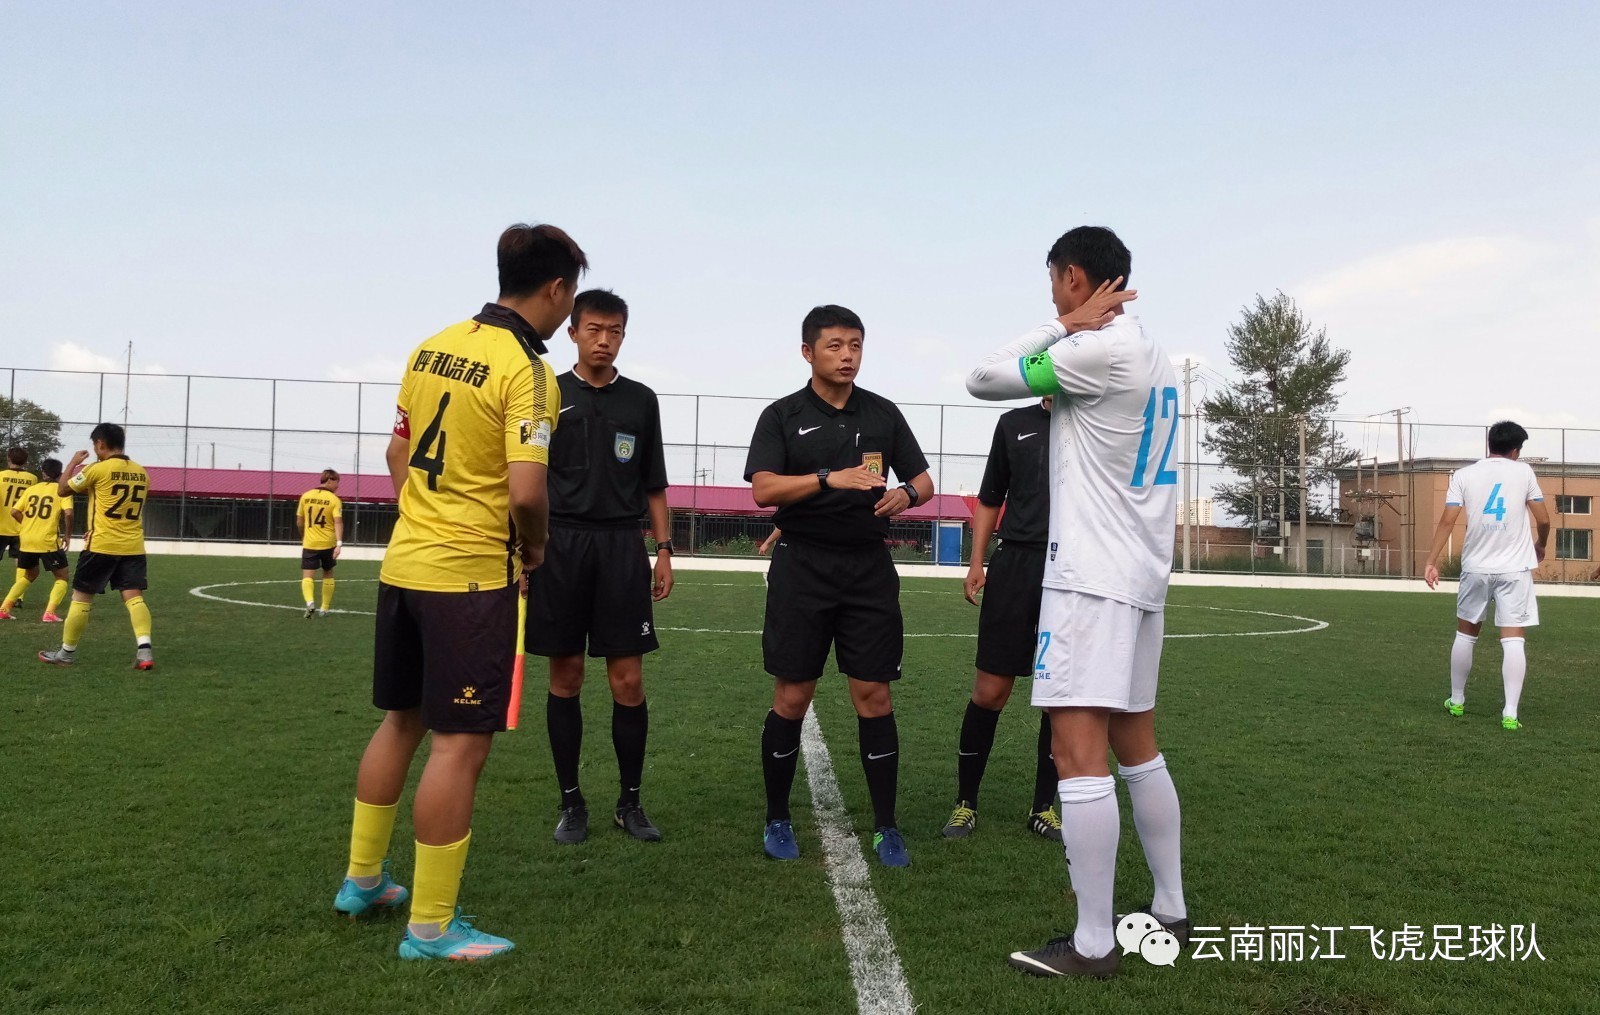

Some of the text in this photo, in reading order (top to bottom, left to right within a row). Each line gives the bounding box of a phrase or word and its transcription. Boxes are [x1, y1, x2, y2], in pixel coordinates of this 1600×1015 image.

[412, 349, 491, 389] 呼和浩特
[408, 391, 451, 492] 4
[1130, 386, 1179, 488] 12
[25, 495, 54, 520] 36
[104, 484, 146, 521] 25
[308, 506, 327, 529] 14
[1482, 483, 1507, 522] 4
[1036, 631, 1052, 670] 2
